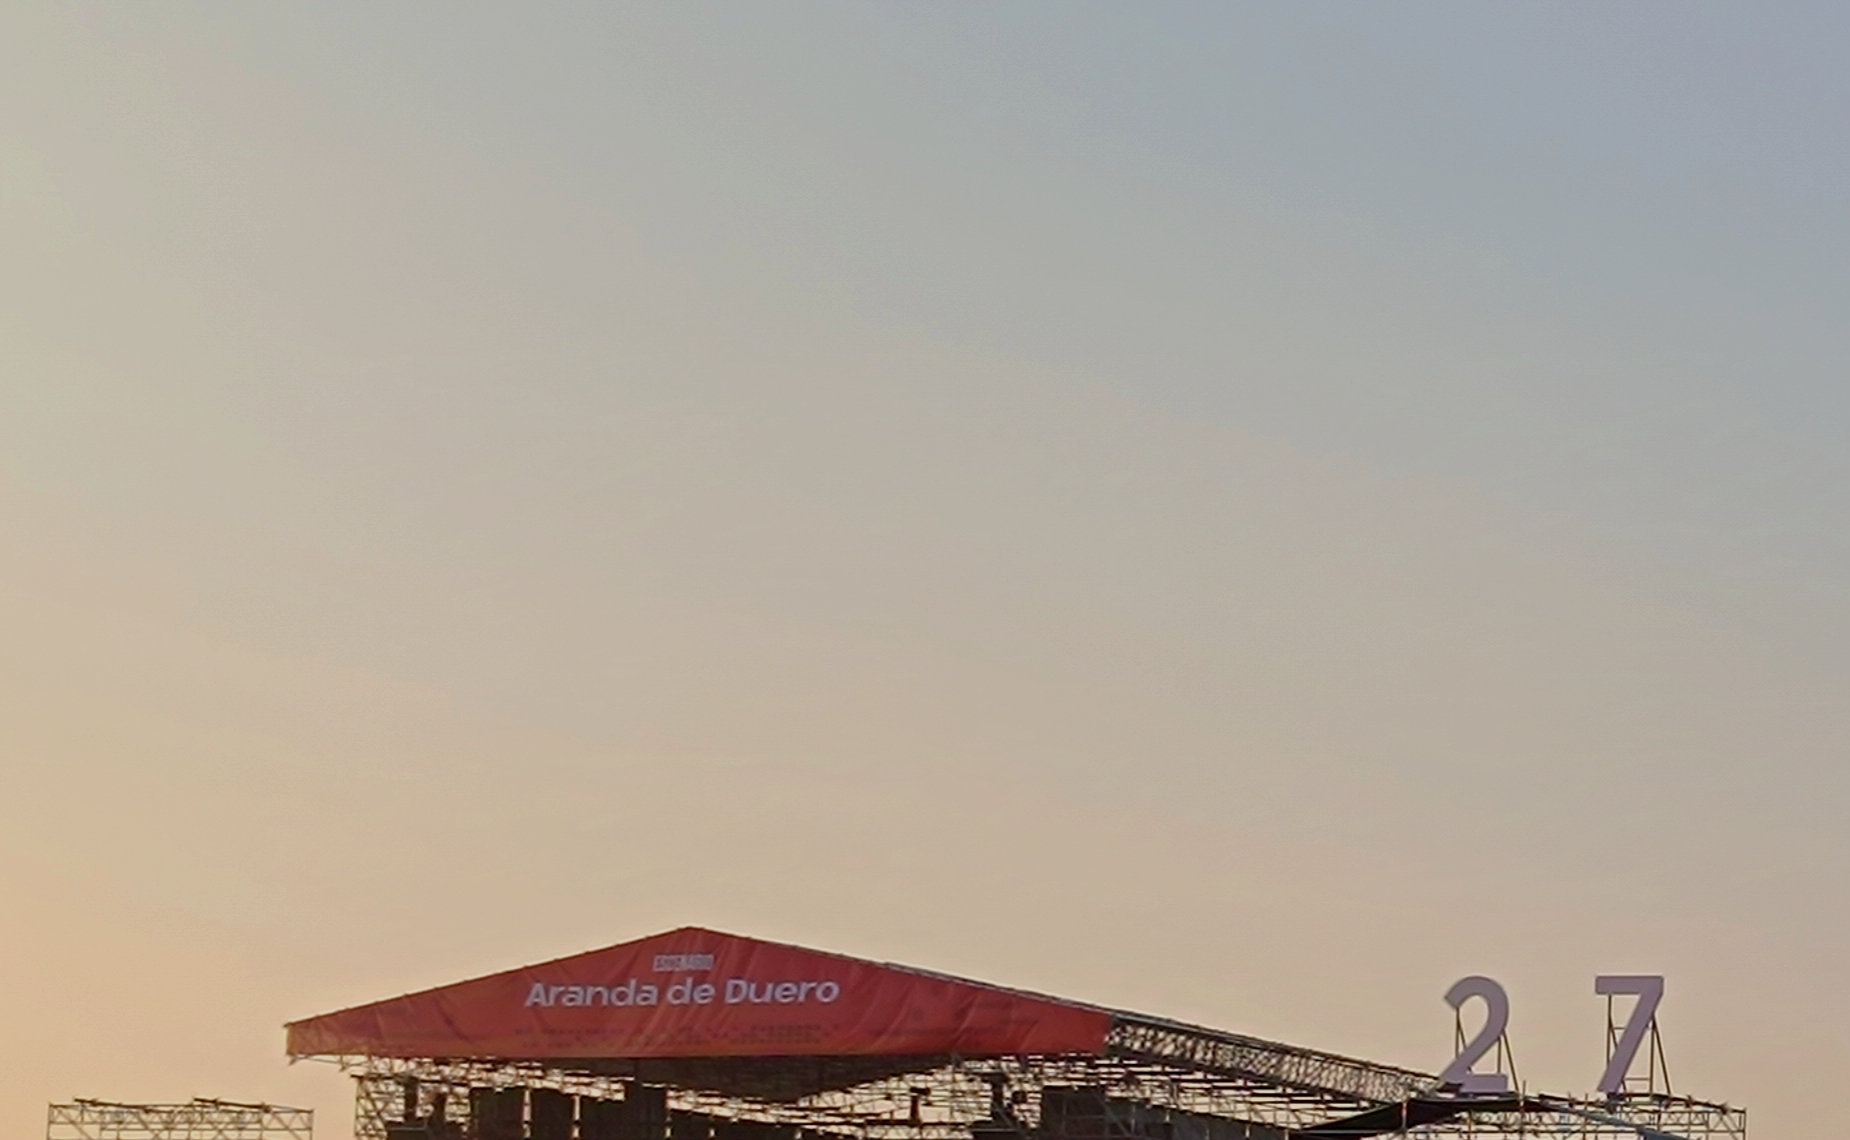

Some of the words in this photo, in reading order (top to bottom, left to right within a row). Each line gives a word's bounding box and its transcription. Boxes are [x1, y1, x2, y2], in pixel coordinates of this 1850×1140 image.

[524, 978, 658, 1008] Aranda
[666, 977, 716, 1006] de
[725, 980, 841, 1005] Duero
